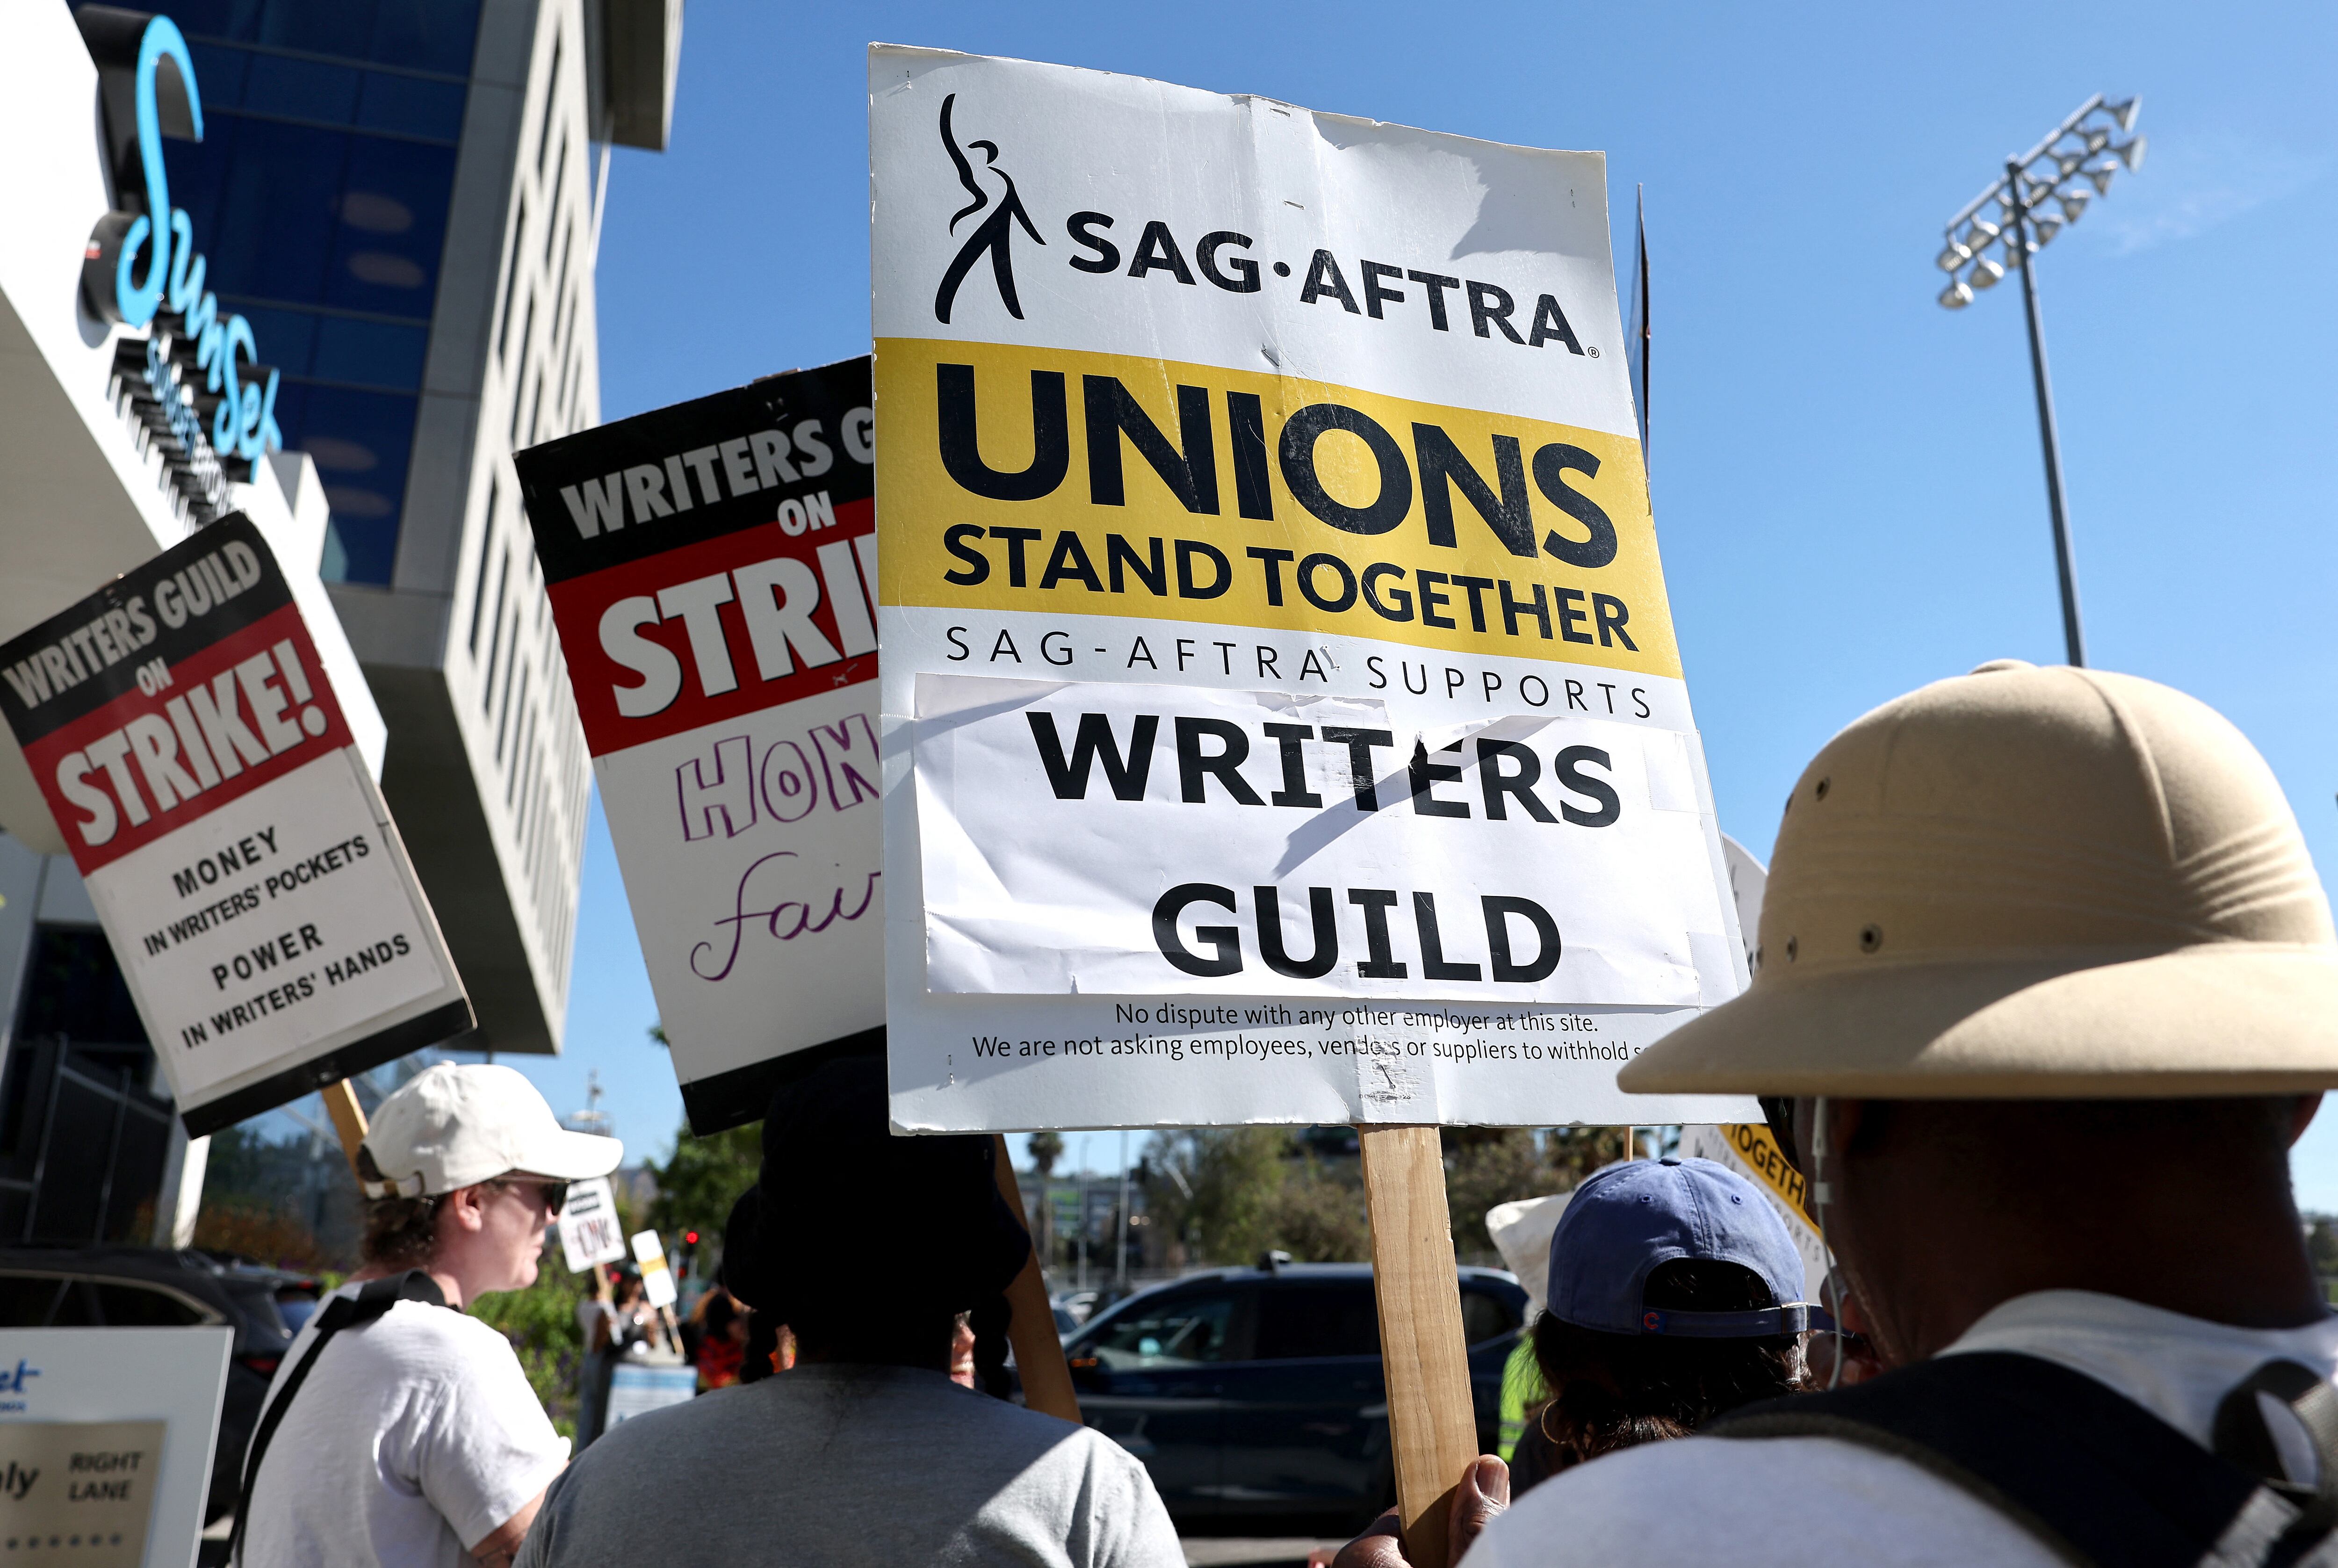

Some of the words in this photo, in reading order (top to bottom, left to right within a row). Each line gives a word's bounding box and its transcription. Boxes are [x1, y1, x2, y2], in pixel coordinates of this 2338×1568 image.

[560, 419, 834, 540] WRITERS
[777, 491, 837, 536] ON
[937, 363, 1618, 570] UNIONS
[2, 595, 157, 709] WRITERS
[154, 541, 261, 629] GUILD
[943, 523, 1233, 600] STAND
[1246, 547, 1640, 653] TOGETHER
[136, 657, 174, 696] ON
[946, 626, 1329, 682] SAG-AFTRA
[1367, 656, 1652, 720] SUPPORTS
[56, 638, 327, 846] STRIKE!
[1025, 712, 1622, 828] WRITERS
[143, 931, 169, 957] IN
[168, 885, 260, 944] WRITERS'
[266, 836, 370, 898] POCKETS
[171, 826, 280, 898] MONEY
[211, 923, 324, 990] POWER
[1151, 883, 1562, 983] GUILD
[181, 1022, 209, 1049] IN
[210, 975, 316, 1035] WRITERS'
[325, 934, 411, 986] HANDS
[1116, 1004, 1149, 1024] No
[1156, 1003, 1238, 1029] dispute
[1244, 1004, 1292, 1025] with
[1299, 1010, 1335, 1031] any
[1342, 1004, 1397, 1026] other
[1403, 1009, 1490, 1034] employer
[1496, 1014, 1515, 1030] at
[1520, 1012, 1554, 1032] this
[1560, 1014, 1598, 1032] site.
[973, 1036, 1011, 1057] We
[1019, 1041, 1055, 1056] are
[1064, 1036, 1102, 1055] not
[1111, 1034, 1183, 1061] asking
[1190, 1034, 1313, 1060] employees,
[1407, 1042, 1427, 1056] or
[1433, 1040, 1517, 1064] suppliers
[1522, 1043, 1543, 1060] to
[1550, 1041, 1629, 1061] withhold
[69, 1452, 142, 1472] RIGHT
[69, 1480, 130, 1500] LANE
